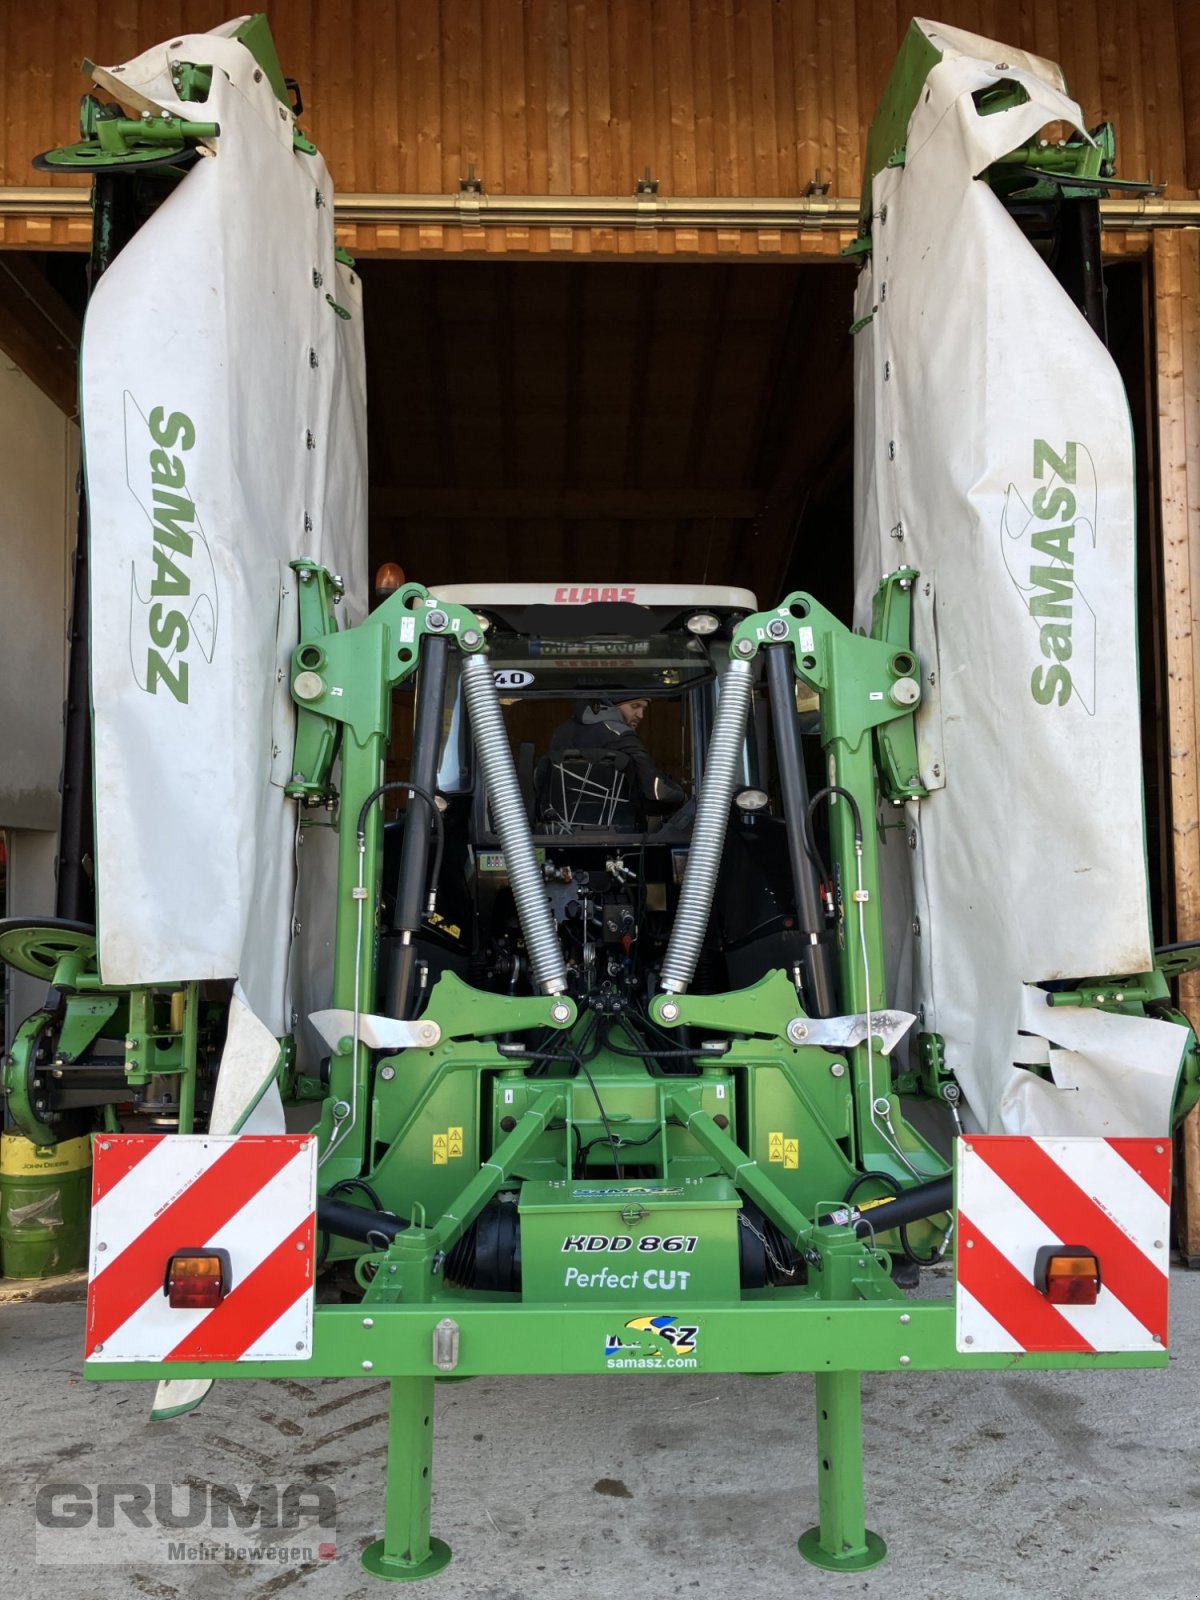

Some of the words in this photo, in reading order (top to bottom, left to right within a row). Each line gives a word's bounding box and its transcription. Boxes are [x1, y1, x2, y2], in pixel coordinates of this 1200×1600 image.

[147, 406, 195, 704] SaMASZ
[1029, 438, 1077, 707] SaMASZ
[554, 588, 635, 603] CLAAS
[495, 673, 524, 684] 40
[561, 1235, 632, 1252] KDD
[637, 1235, 698, 1253] 861
[564, 1267, 639, 1289] Perfect
[643, 1269, 691, 1290] CUT
[607, 1358, 697, 1369] samasz.com
